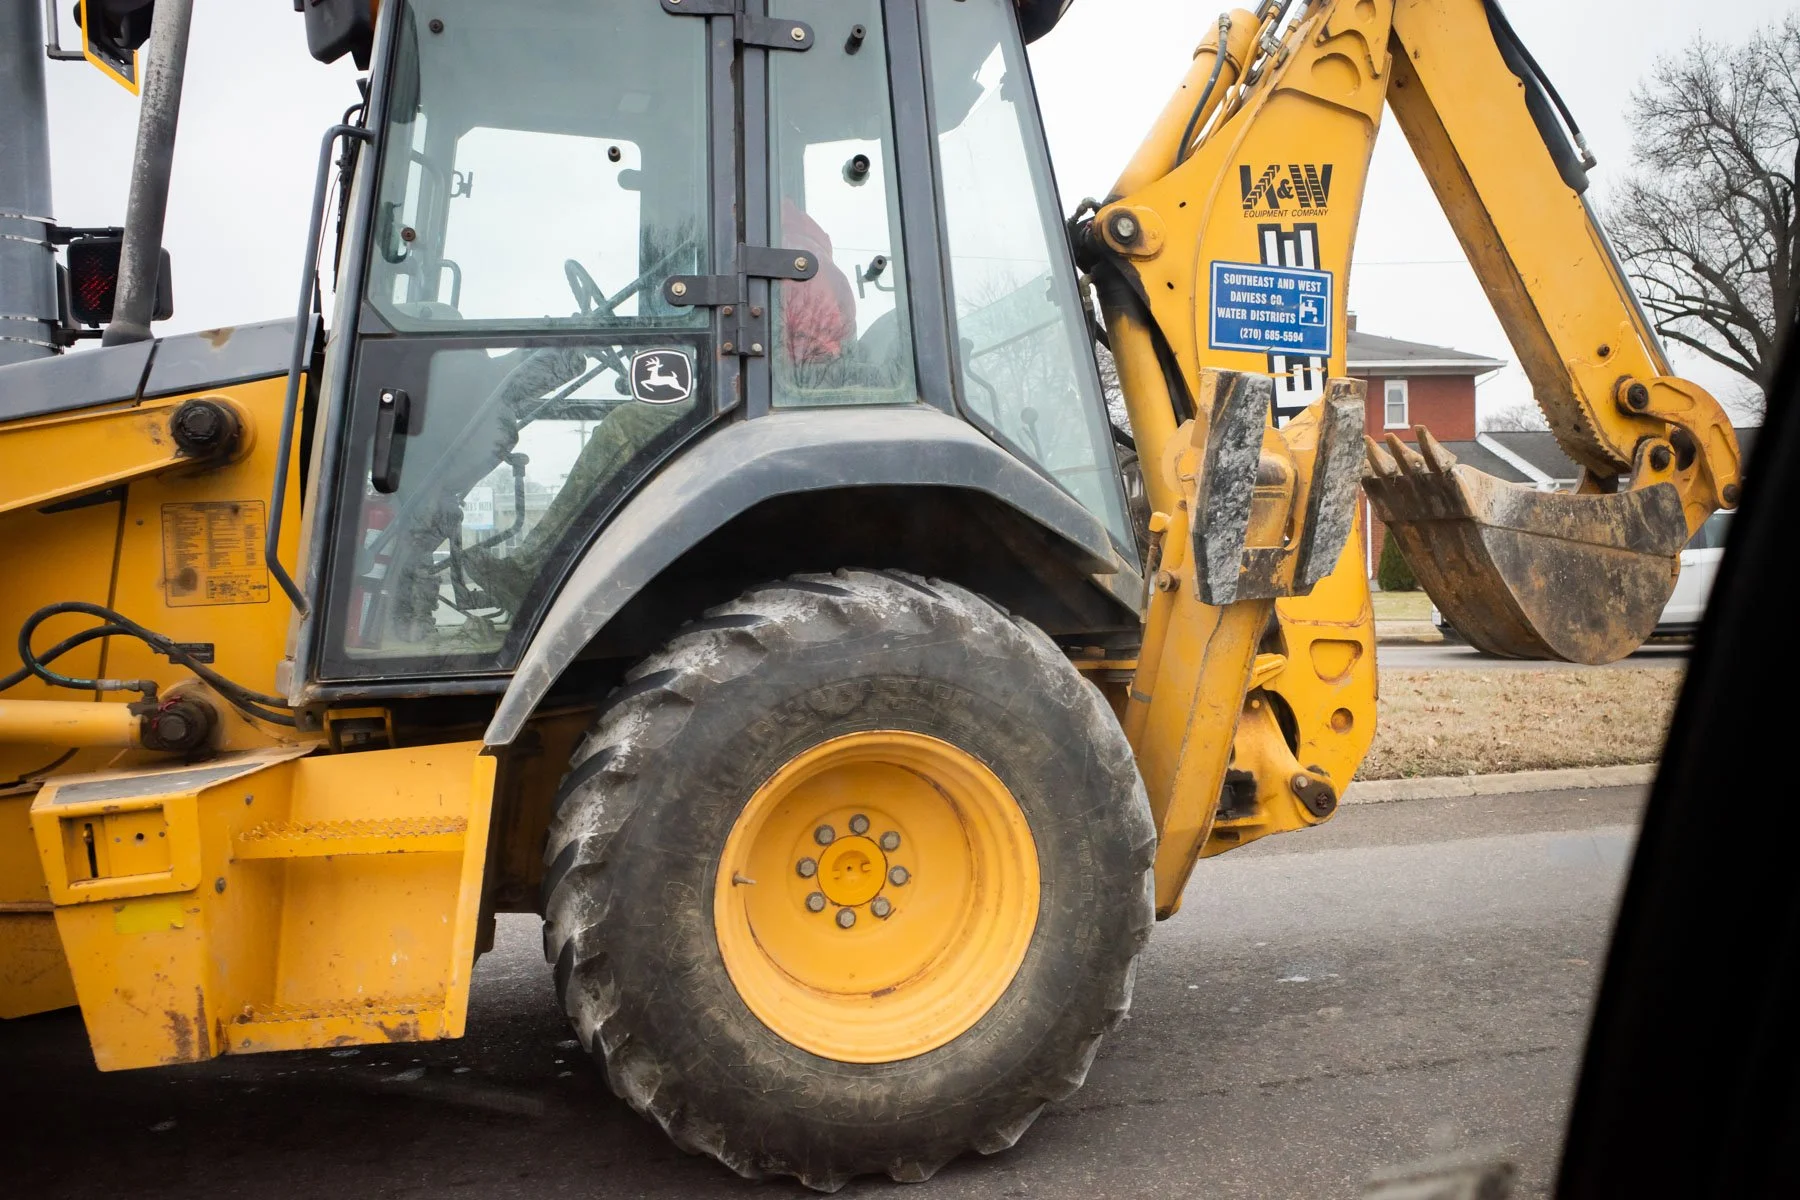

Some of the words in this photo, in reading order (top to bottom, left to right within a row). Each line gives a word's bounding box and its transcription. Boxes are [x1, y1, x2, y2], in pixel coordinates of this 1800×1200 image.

[1239, 163, 1333, 209] K&W
[1243, 209, 1289, 218] EQUIPMENT
[1291, 208, 1329, 217] COMPANY
[1223, 273, 1275, 288] SOUTHEAST
[1277, 278, 1295, 290] AND
[1298, 280, 1322, 293] WEST
[1230, 290, 1267, 304] DAVIESS
[1270, 295, 1285, 306] CO.
[1217, 307, 1247, 320] WATER
[1250, 310, 1296, 324] DISTRICTS
[1240, 327, 1262, 340] (270)
[1264, 329, 1304, 342] 685-5594
